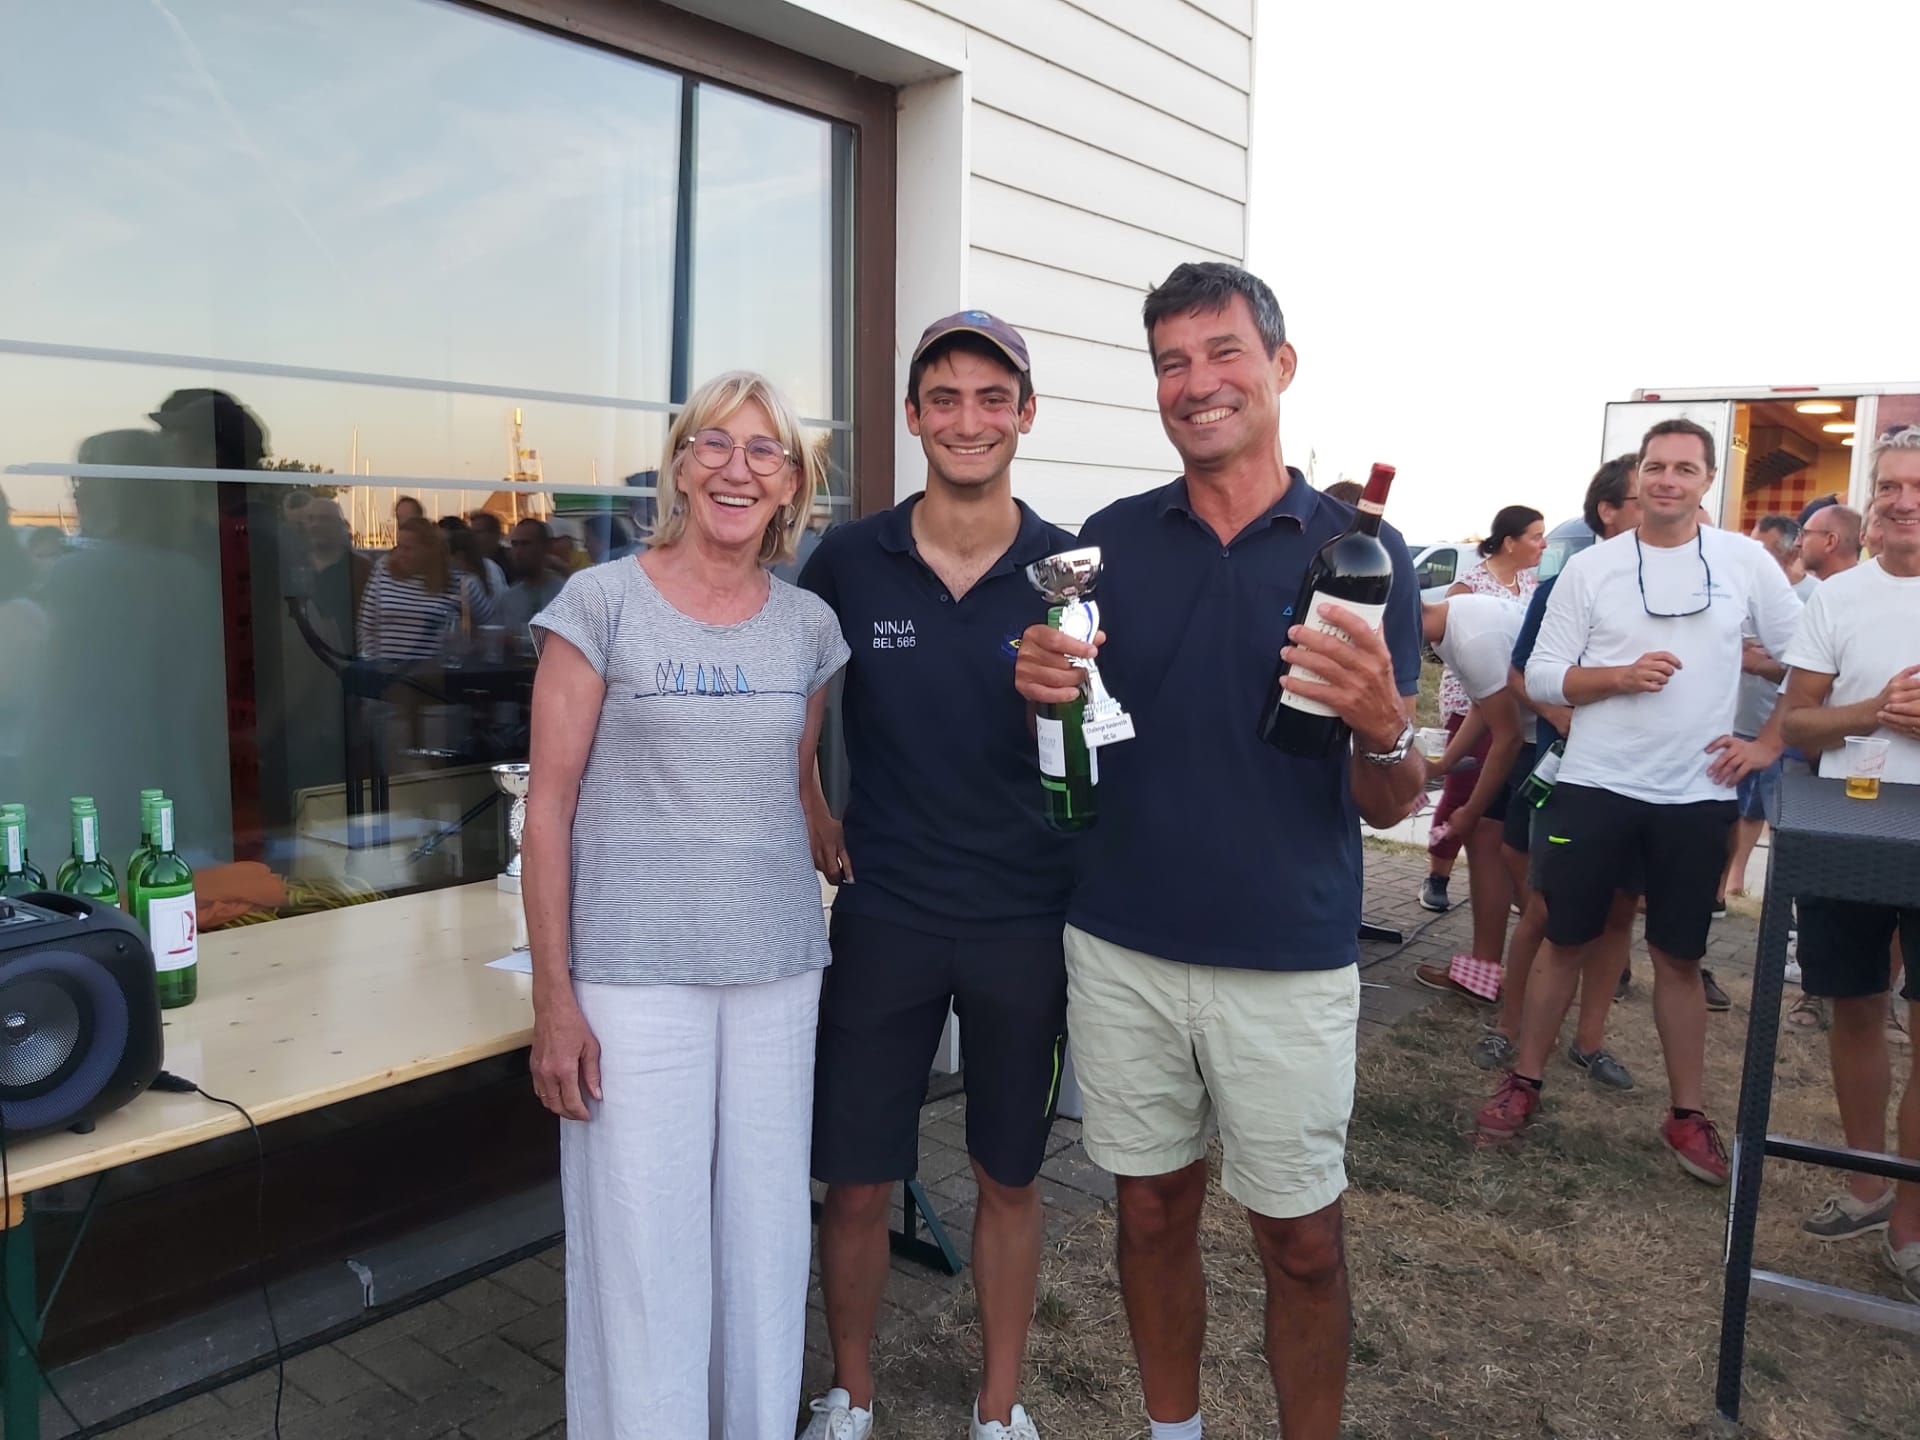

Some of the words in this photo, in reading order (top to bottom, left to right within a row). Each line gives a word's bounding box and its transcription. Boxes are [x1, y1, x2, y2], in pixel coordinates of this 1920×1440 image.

[874, 619, 915, 635] NINJA
[873, 637, 895, 648] BEL
[897, 636, 916, 648] 565
